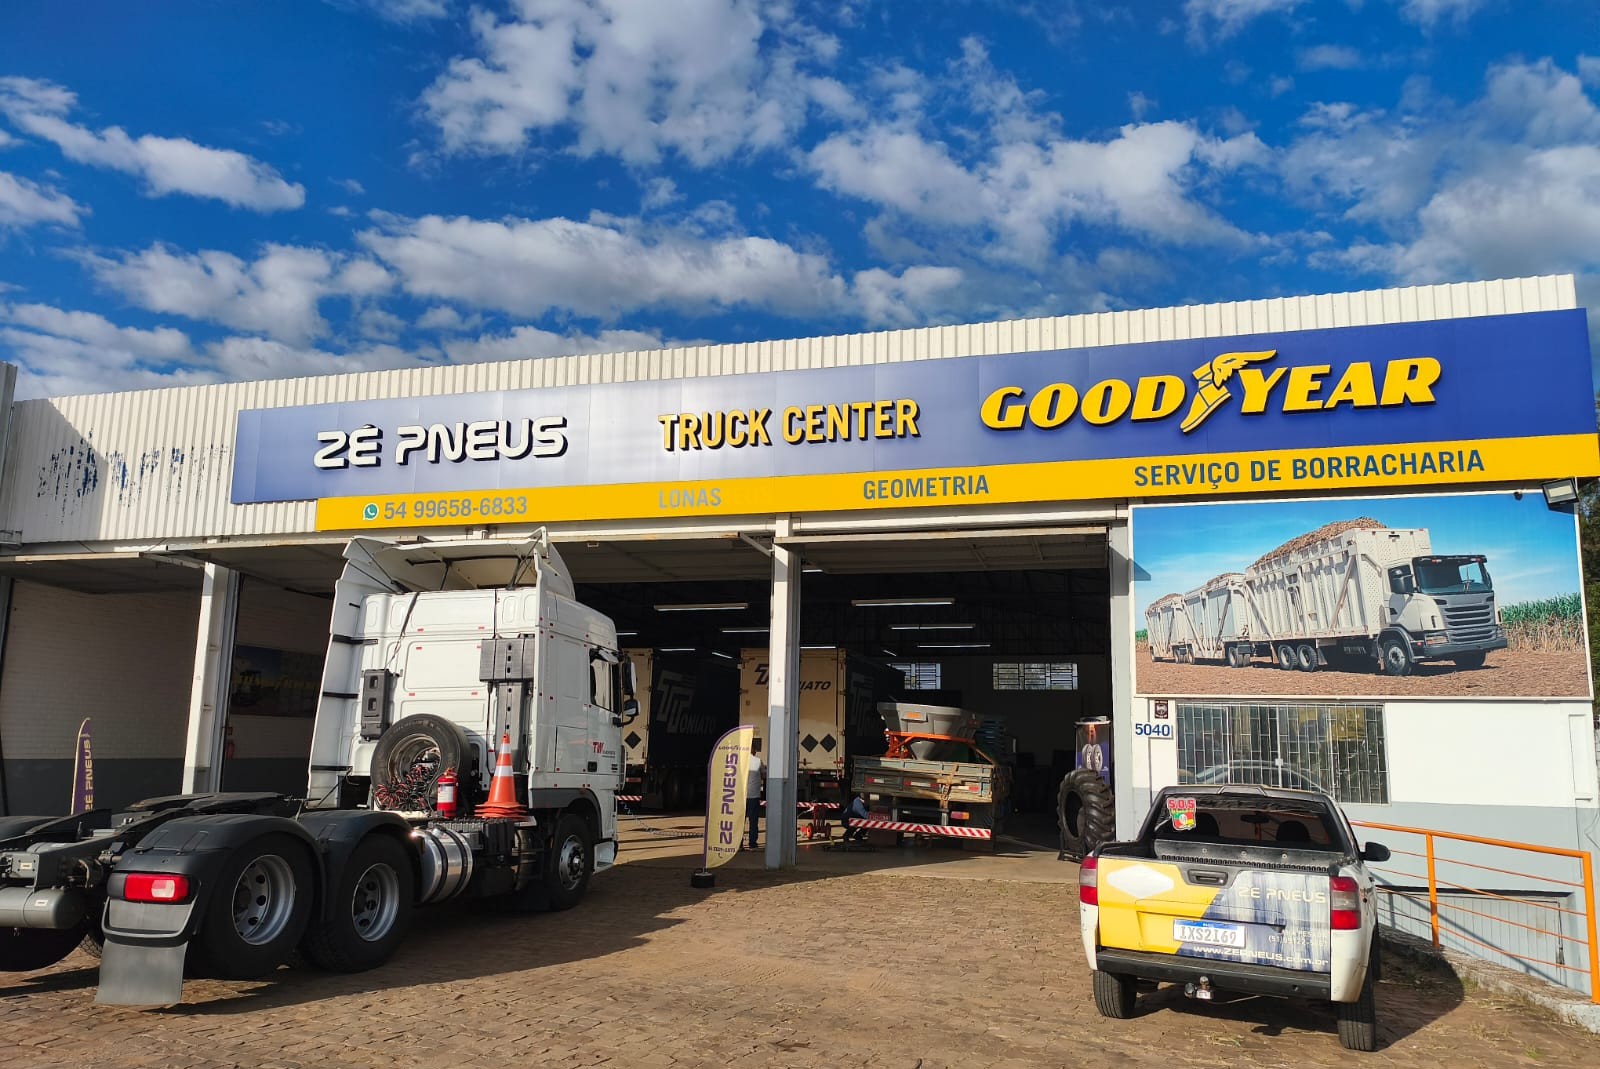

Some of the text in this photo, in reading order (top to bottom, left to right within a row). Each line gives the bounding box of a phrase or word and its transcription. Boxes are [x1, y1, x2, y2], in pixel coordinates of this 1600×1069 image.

[395, 416, 567, 465] PNEUS
[658, 398, 920, 452] TRUCK CENTER
[1134, 450, 1485, 489] SERVIÇO DE BORRACHARIA
[658, 488, 722, 509] LONAS
[863, 474, 989, 501] GEOMETRIA
[384, 496, 527, 519] 54 99658-6833
[1135, 723, 1170, 737] 5040
[83, 739, 94, 790] PNEUS
[721, 753, 739, 815] PNEUS
[1266, 888, 1326, 904] PNEUS
